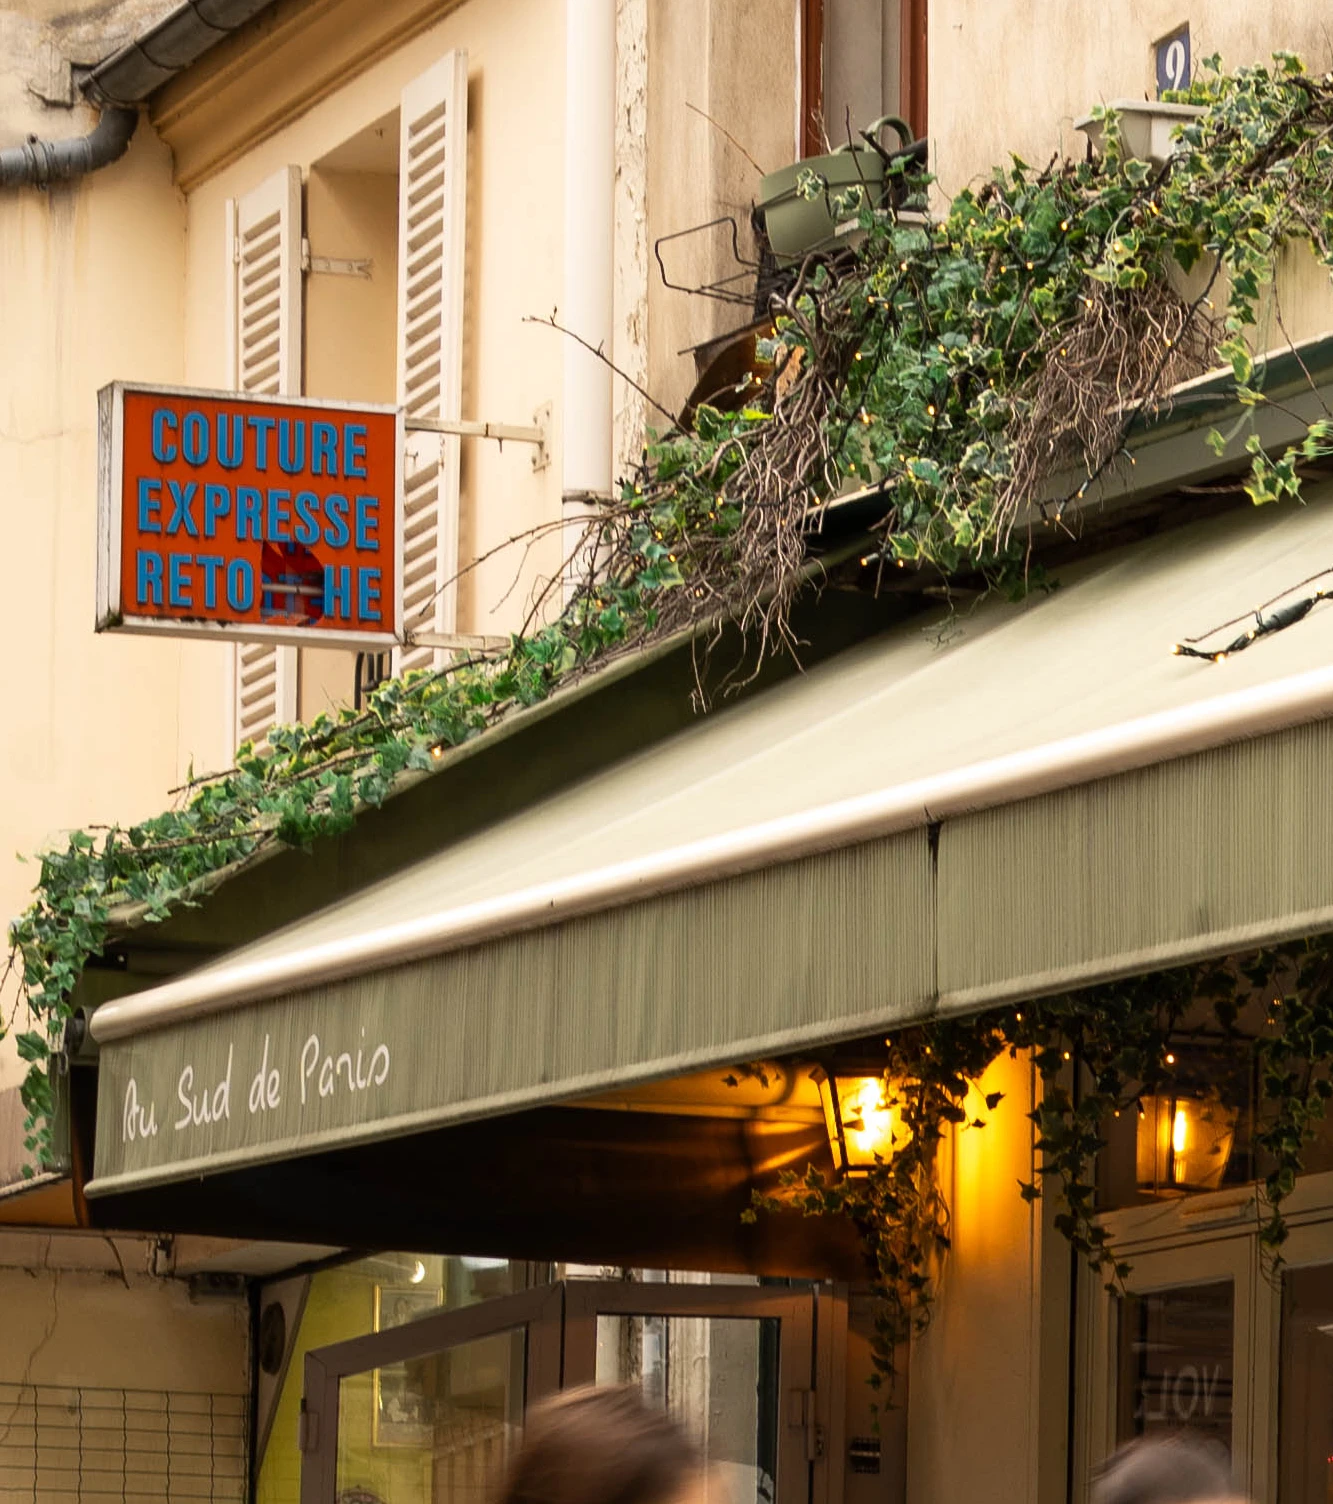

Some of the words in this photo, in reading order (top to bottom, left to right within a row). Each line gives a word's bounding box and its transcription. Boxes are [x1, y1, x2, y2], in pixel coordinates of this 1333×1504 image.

[1165, 40, 1186, 91] 9
[151, 408, 368, 478] COUTURE
[137, 478, 380, 551] EXPRESSE
[136, 549, 383, 622] RETOHE
[122, 1077, 159, 1143] Au
[174, 1043, 234, 1132] Sud
[248, 1033, 282, 1115] de
[299, 1026, 391, 1105] Paris
